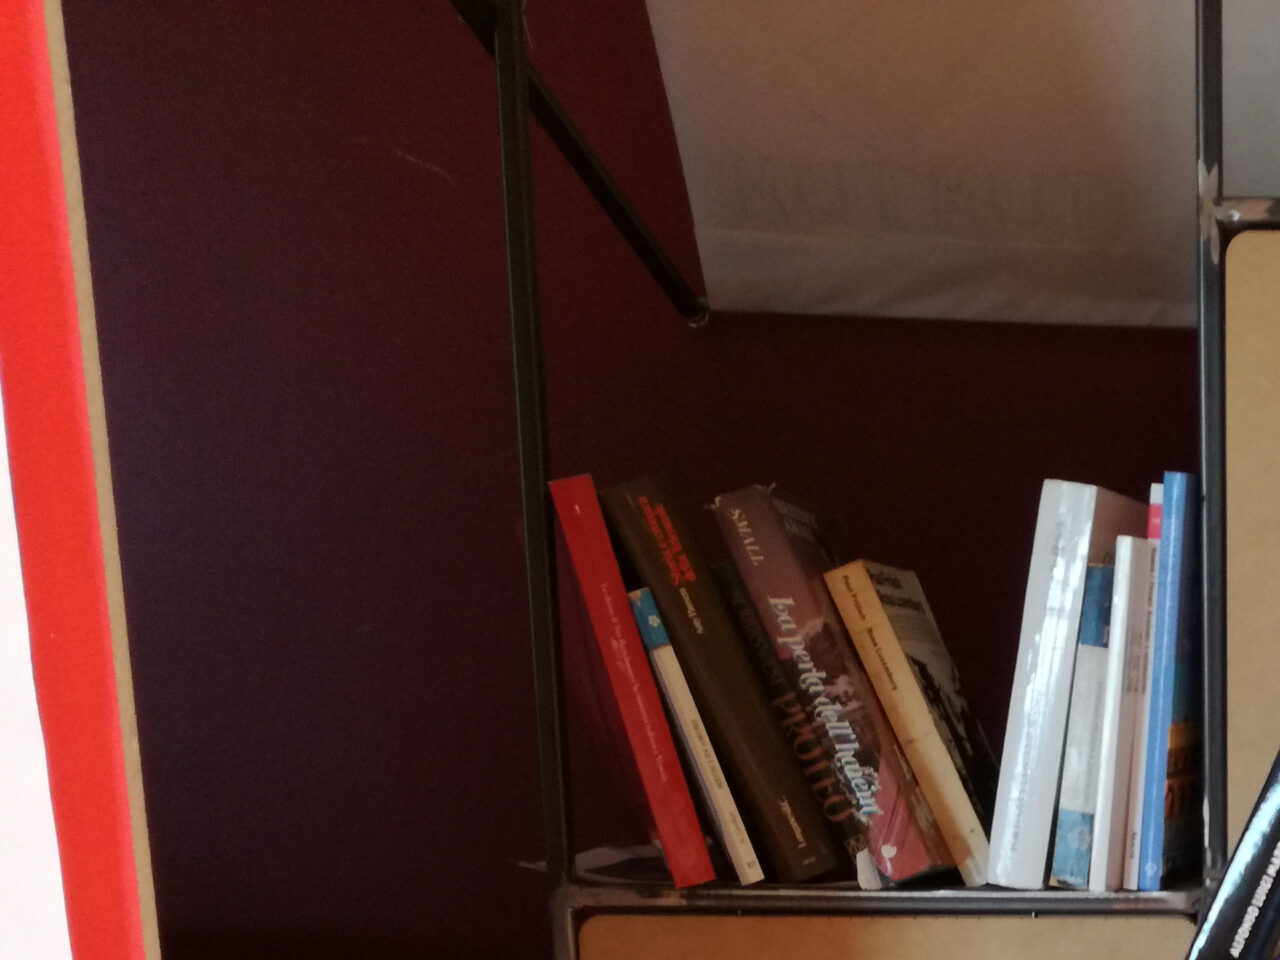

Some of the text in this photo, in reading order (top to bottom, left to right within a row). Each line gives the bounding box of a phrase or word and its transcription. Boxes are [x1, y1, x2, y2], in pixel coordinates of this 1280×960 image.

[730, 507, 762, 567] SMALL
[767, 588, 804, 633] La
[776, 625, 833, 700] perla
[770, 689, 852, 827] PROTEO
